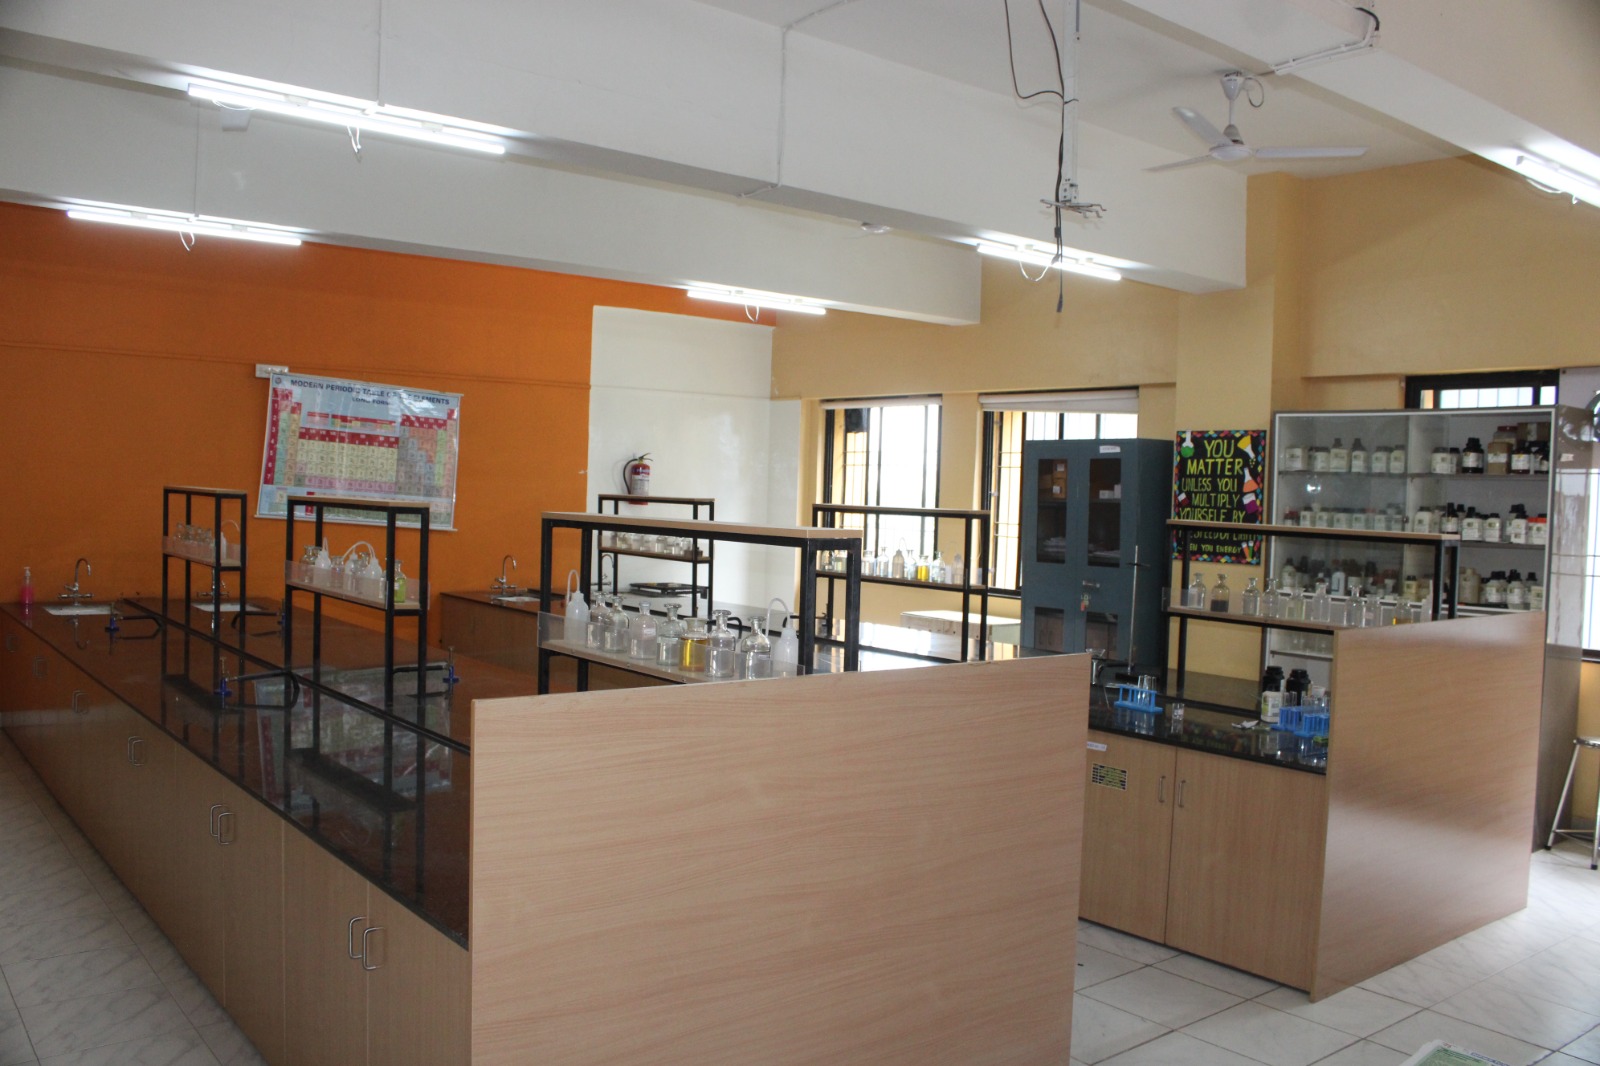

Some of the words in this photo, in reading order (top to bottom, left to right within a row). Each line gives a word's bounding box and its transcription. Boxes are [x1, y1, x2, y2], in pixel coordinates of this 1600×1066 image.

[290, 379, 324, 389] MODERN
[1204, 439, 1235, 458] YOU
[1186, 458, 1244, 475] MATTER
[1181, 477, 1212, 492] UNLESS
[1217, 478, 1238, 492] YOU
[1191, 493, 1240, 508] MULTIPLY
[1179, 507, 1228, 522] YOURSELF
[1232, 510, 1246, 523] BY
[1215, 545, 1242, 554] ENERGY
